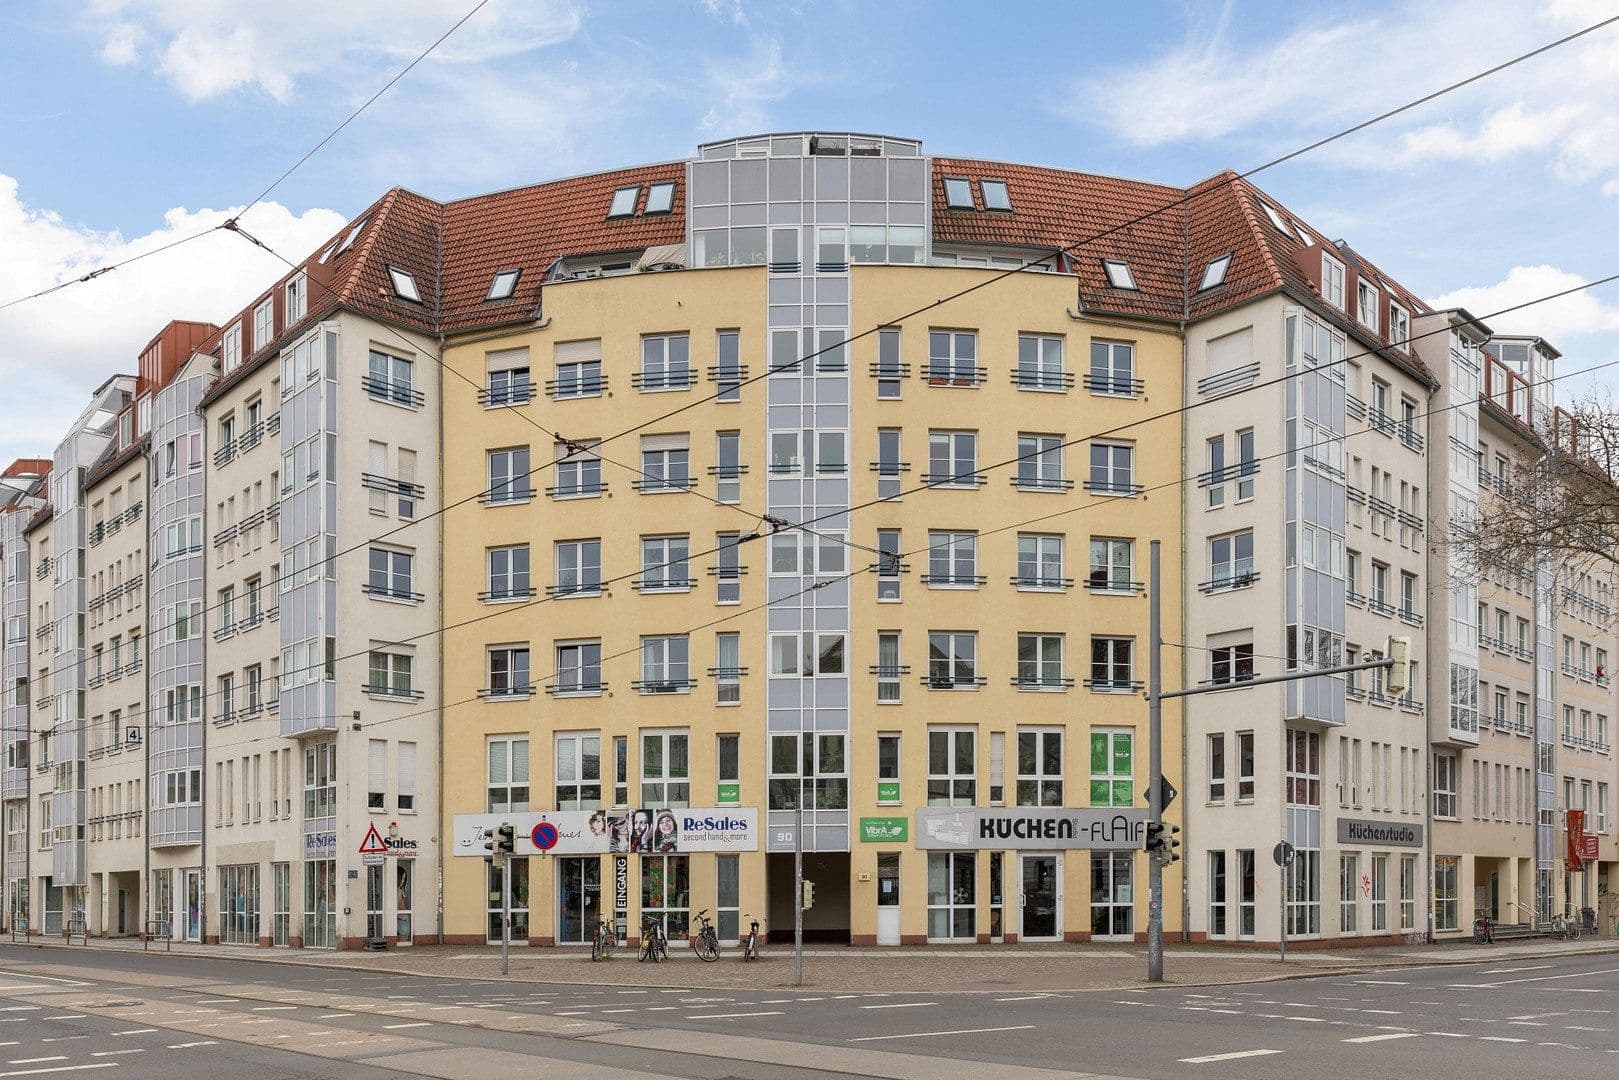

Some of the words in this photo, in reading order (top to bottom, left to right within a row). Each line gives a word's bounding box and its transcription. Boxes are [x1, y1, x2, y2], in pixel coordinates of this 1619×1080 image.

[130, 730, 137, 739] 4
[683, 816, 748, 831] ReSales
[979, 818, 1073, 839] KÜCHEN
[683, 832, 706, 841] second
[777, 832, 793, 842] 90
[1349, 823, 1414, 841] Küchenstudio
[307, 833, 336, 848] ReSaes
[384, 837, 417, 848] Sales
[617, 858, 627, 907] EINGANG
